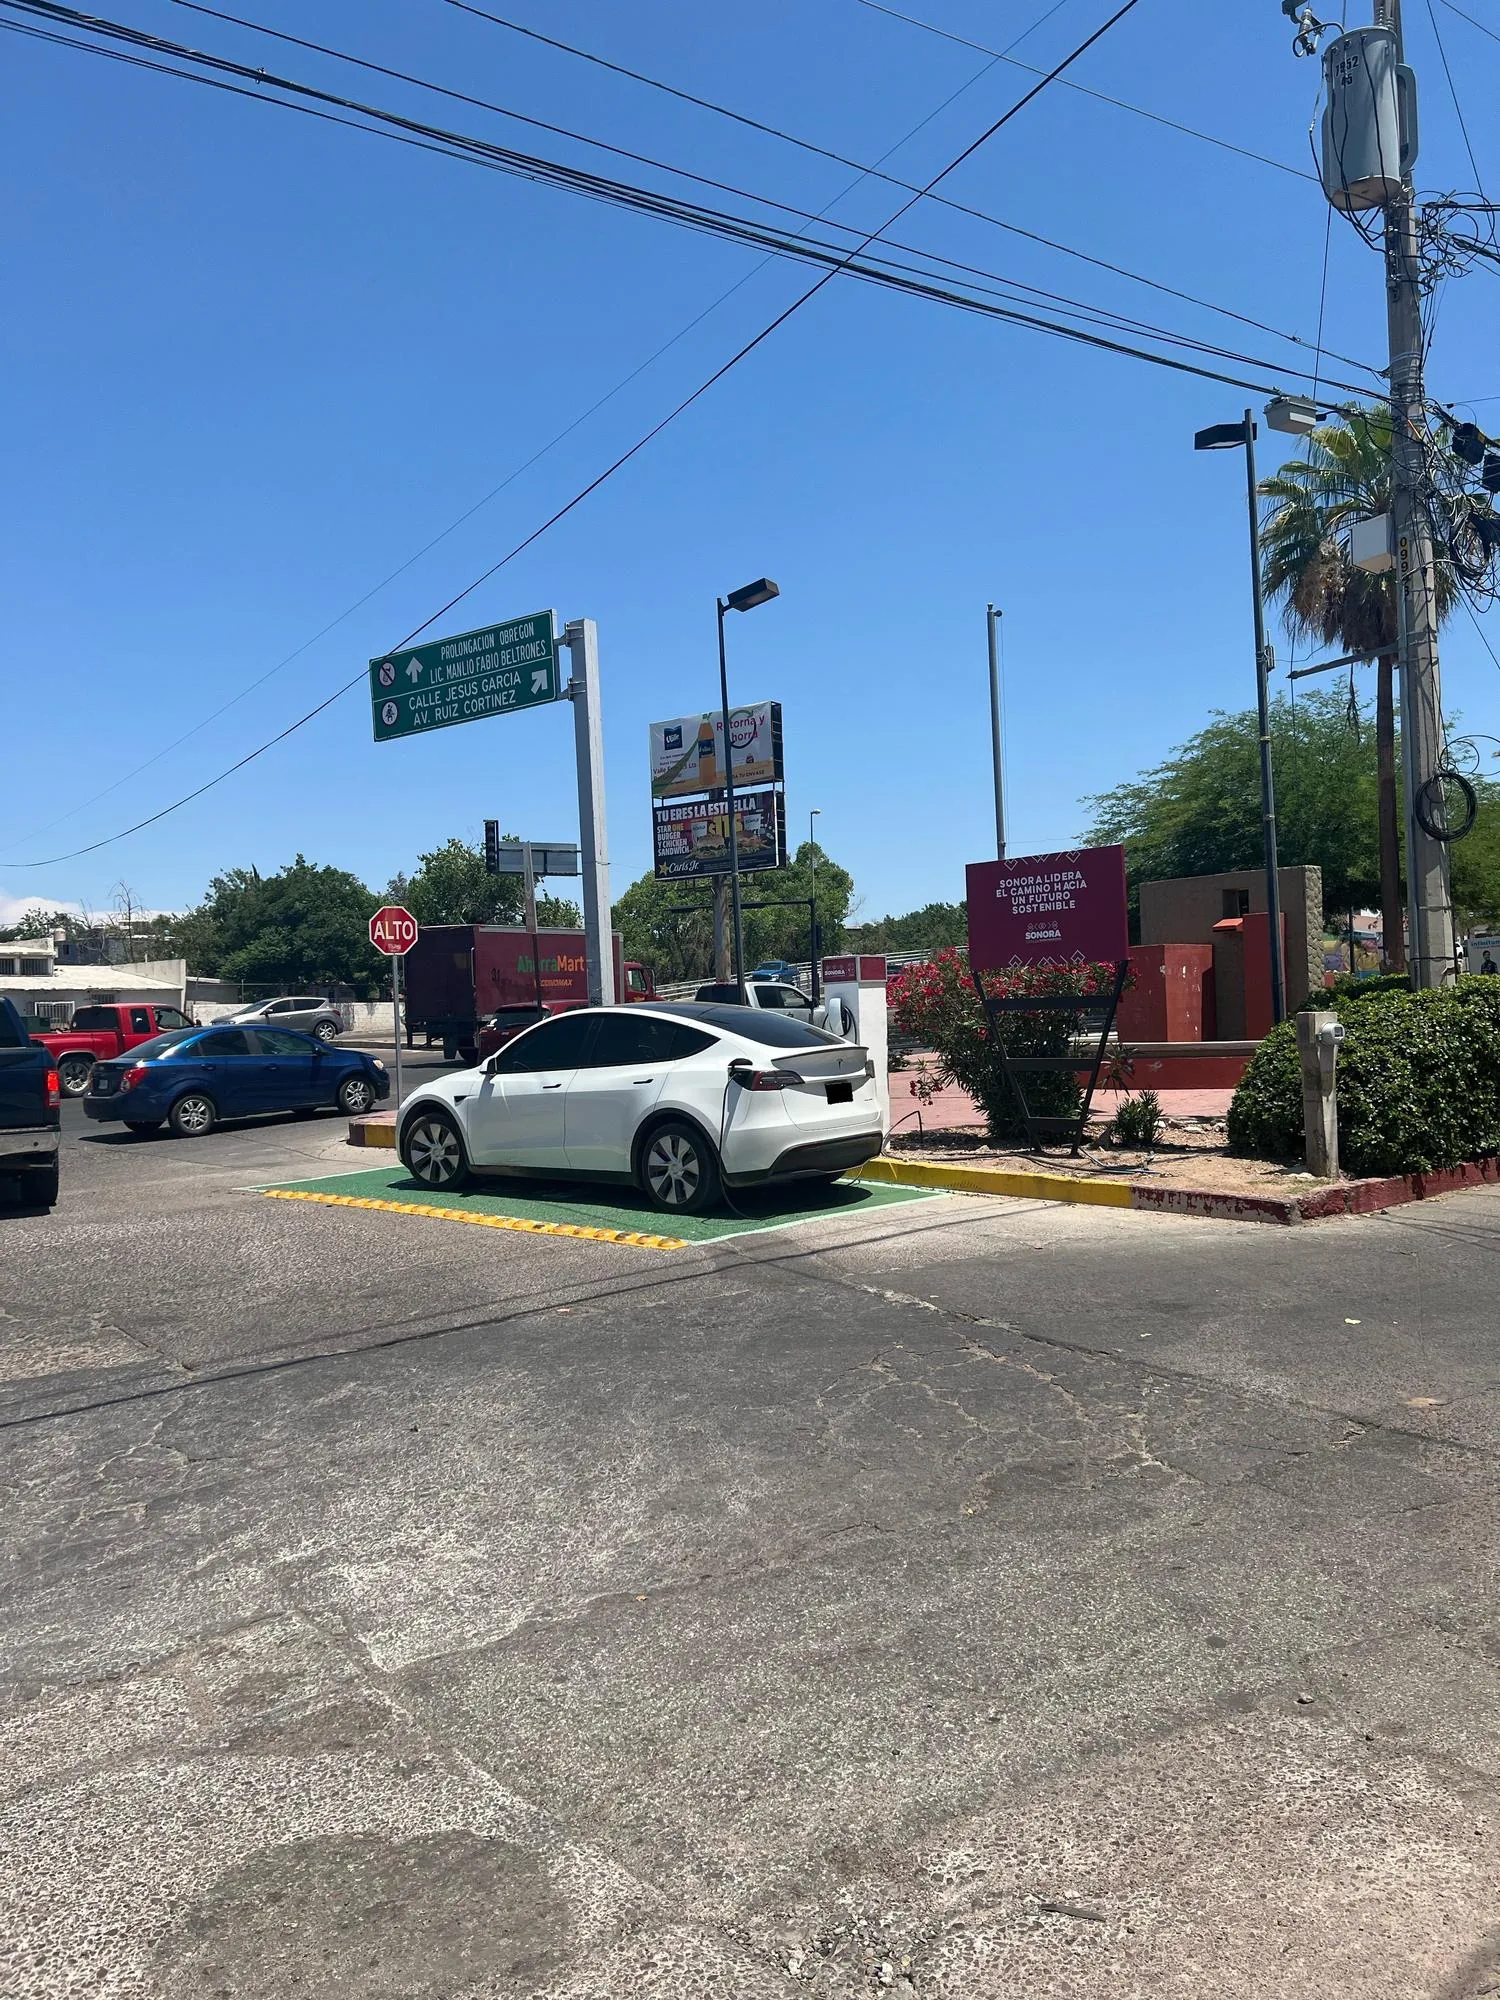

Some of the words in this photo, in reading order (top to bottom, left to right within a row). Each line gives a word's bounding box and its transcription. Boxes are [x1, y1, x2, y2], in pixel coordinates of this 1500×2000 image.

[440, 633, 495, 661] PROLONGACION
[499, 621, 535, 645] OBREGON
[446, 659, 475, 680] MANLIO
[476, 654, 499, 673] FABIO
[500, 640, 546, 666] BELTRONES
[408, 691, 441, 711] CALLE
[445, 682, 477, 702] JESUS
[481, 670, 522, 692] GARCIA
[413, 710, 431, 726] AV.
[435, 703, 459, 722] RUIZ
[463, 689, 516, 715] CORTINEZ
[716, 717, 756, 731] Rtorna
[759, 715, 765, 726] y
[731, 731, 758, 742] horra
[656, 810, 669, 822] TU
[670, 806, 693, 821] ERES
[694, 804, 707, 818] LA
[657, 824, 671, 834] STAR
[672, 823, 684, 831] ONE
[657, 831, 681, 841] BURGER
[662, 838, 688, 848] CHICKEN
[658, 846, 690, 857] SANDWICH
[999, 876, 1043, 889] SONORA
[1045, 871, 1083, 883] LIDERA
[996, 889, 1008, 898] EL
[1010, 884, 1050, 896] CAMINO
[1054, 879, 1087, 892] HACIA
[1011, 896, 1026, 906] UN
[1029, 891, 1071, 904] FUTURO
[1012, 900, 1076, 915] SOSTENIBLE
[373, 920, 414, 940] ALTO
[1025, 929, 1062, 940] SONORA
